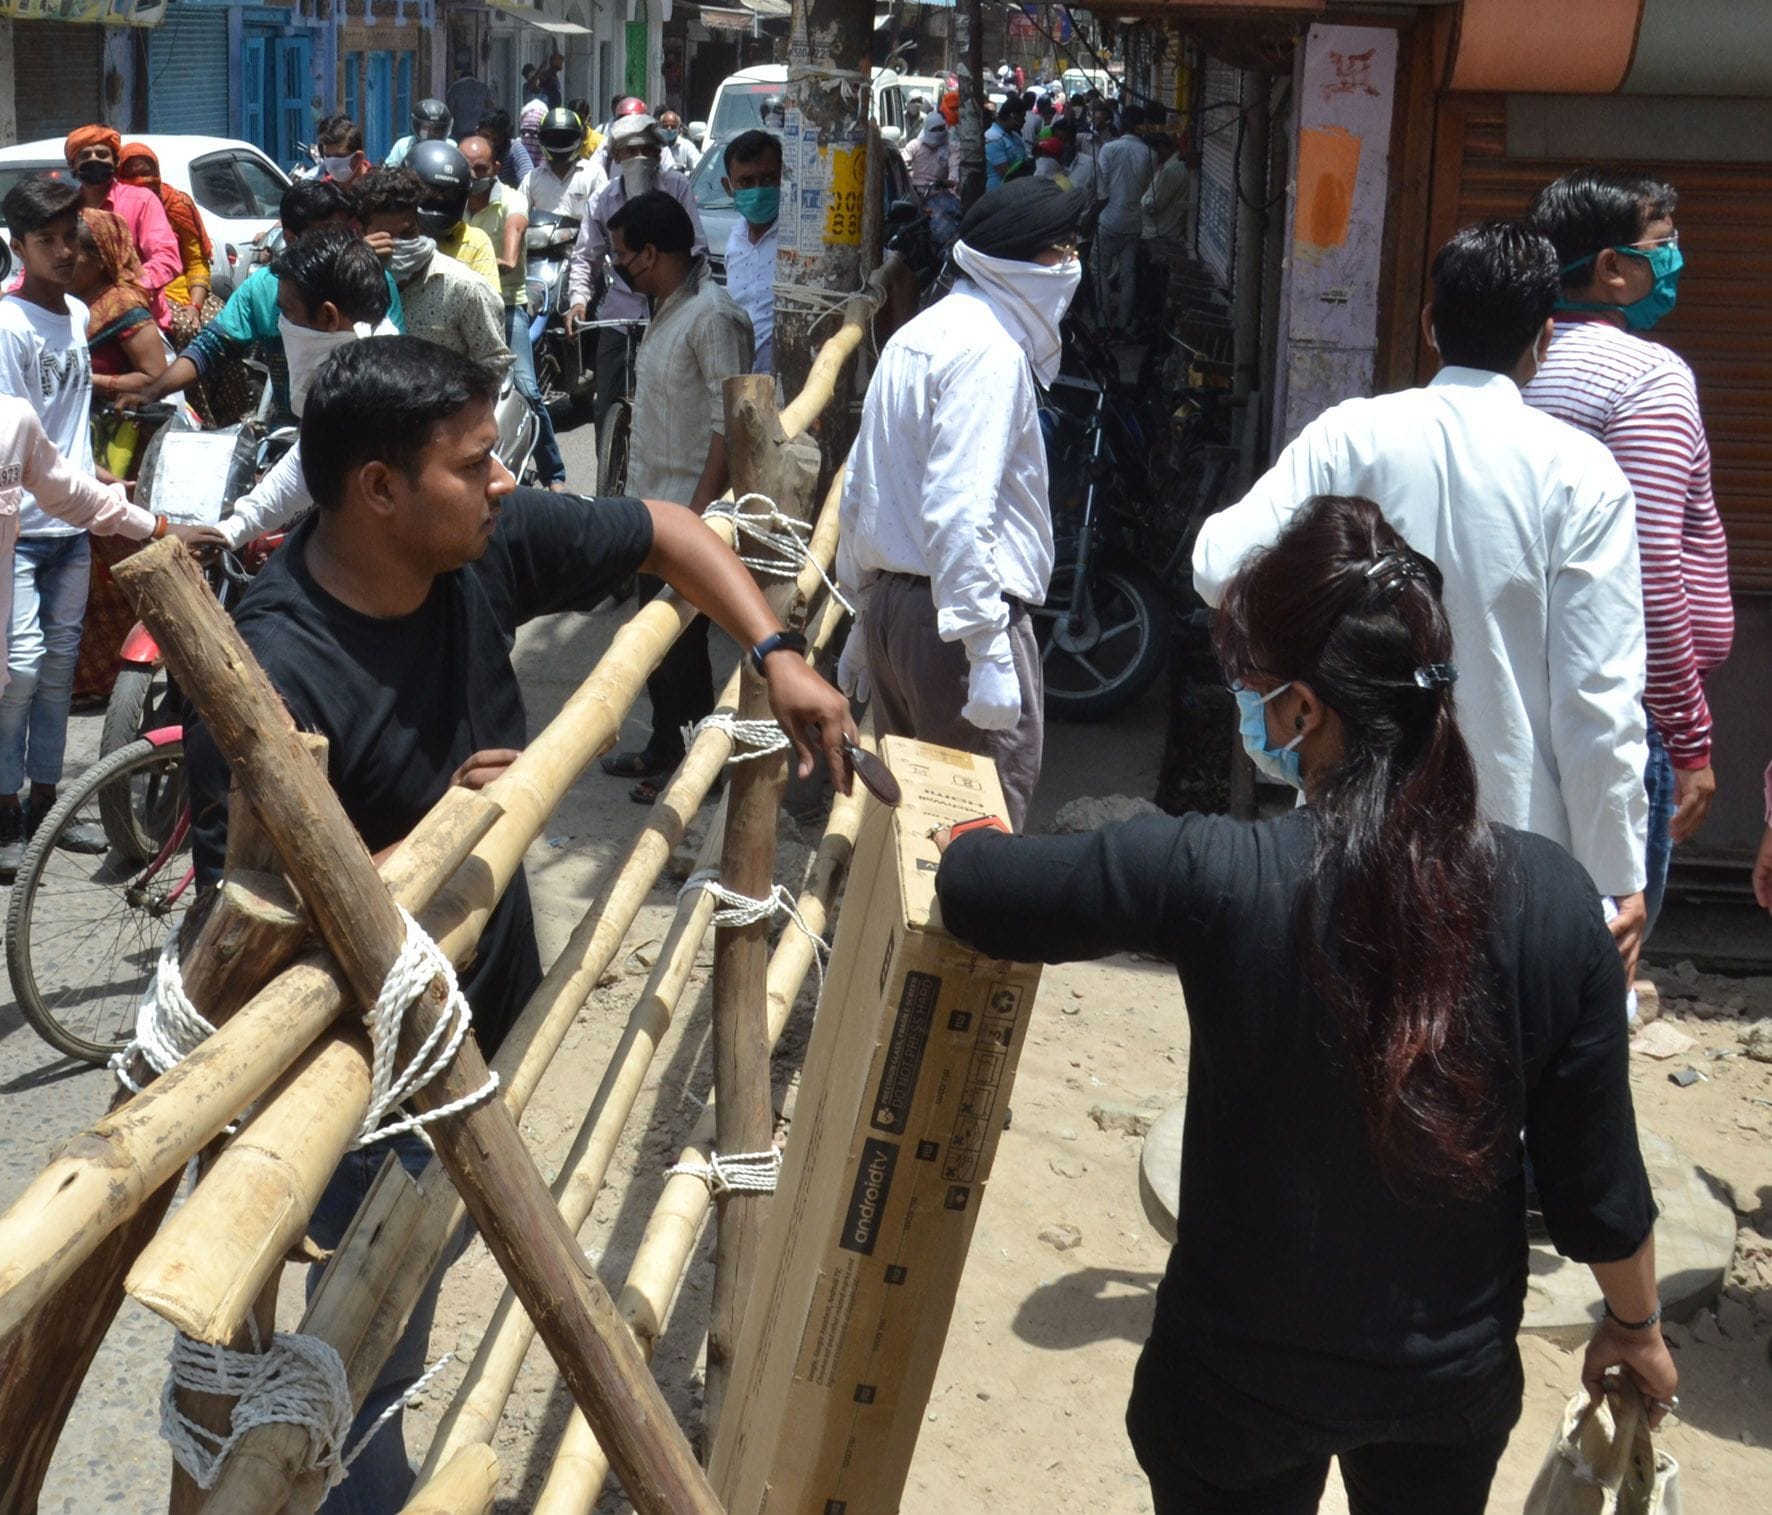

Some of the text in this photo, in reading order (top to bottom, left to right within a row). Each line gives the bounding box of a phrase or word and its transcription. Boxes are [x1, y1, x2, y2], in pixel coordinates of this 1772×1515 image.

[0, 467, 19, 486] 973
[892, 977, 933, 1108] DO NOT PRESS HARD
